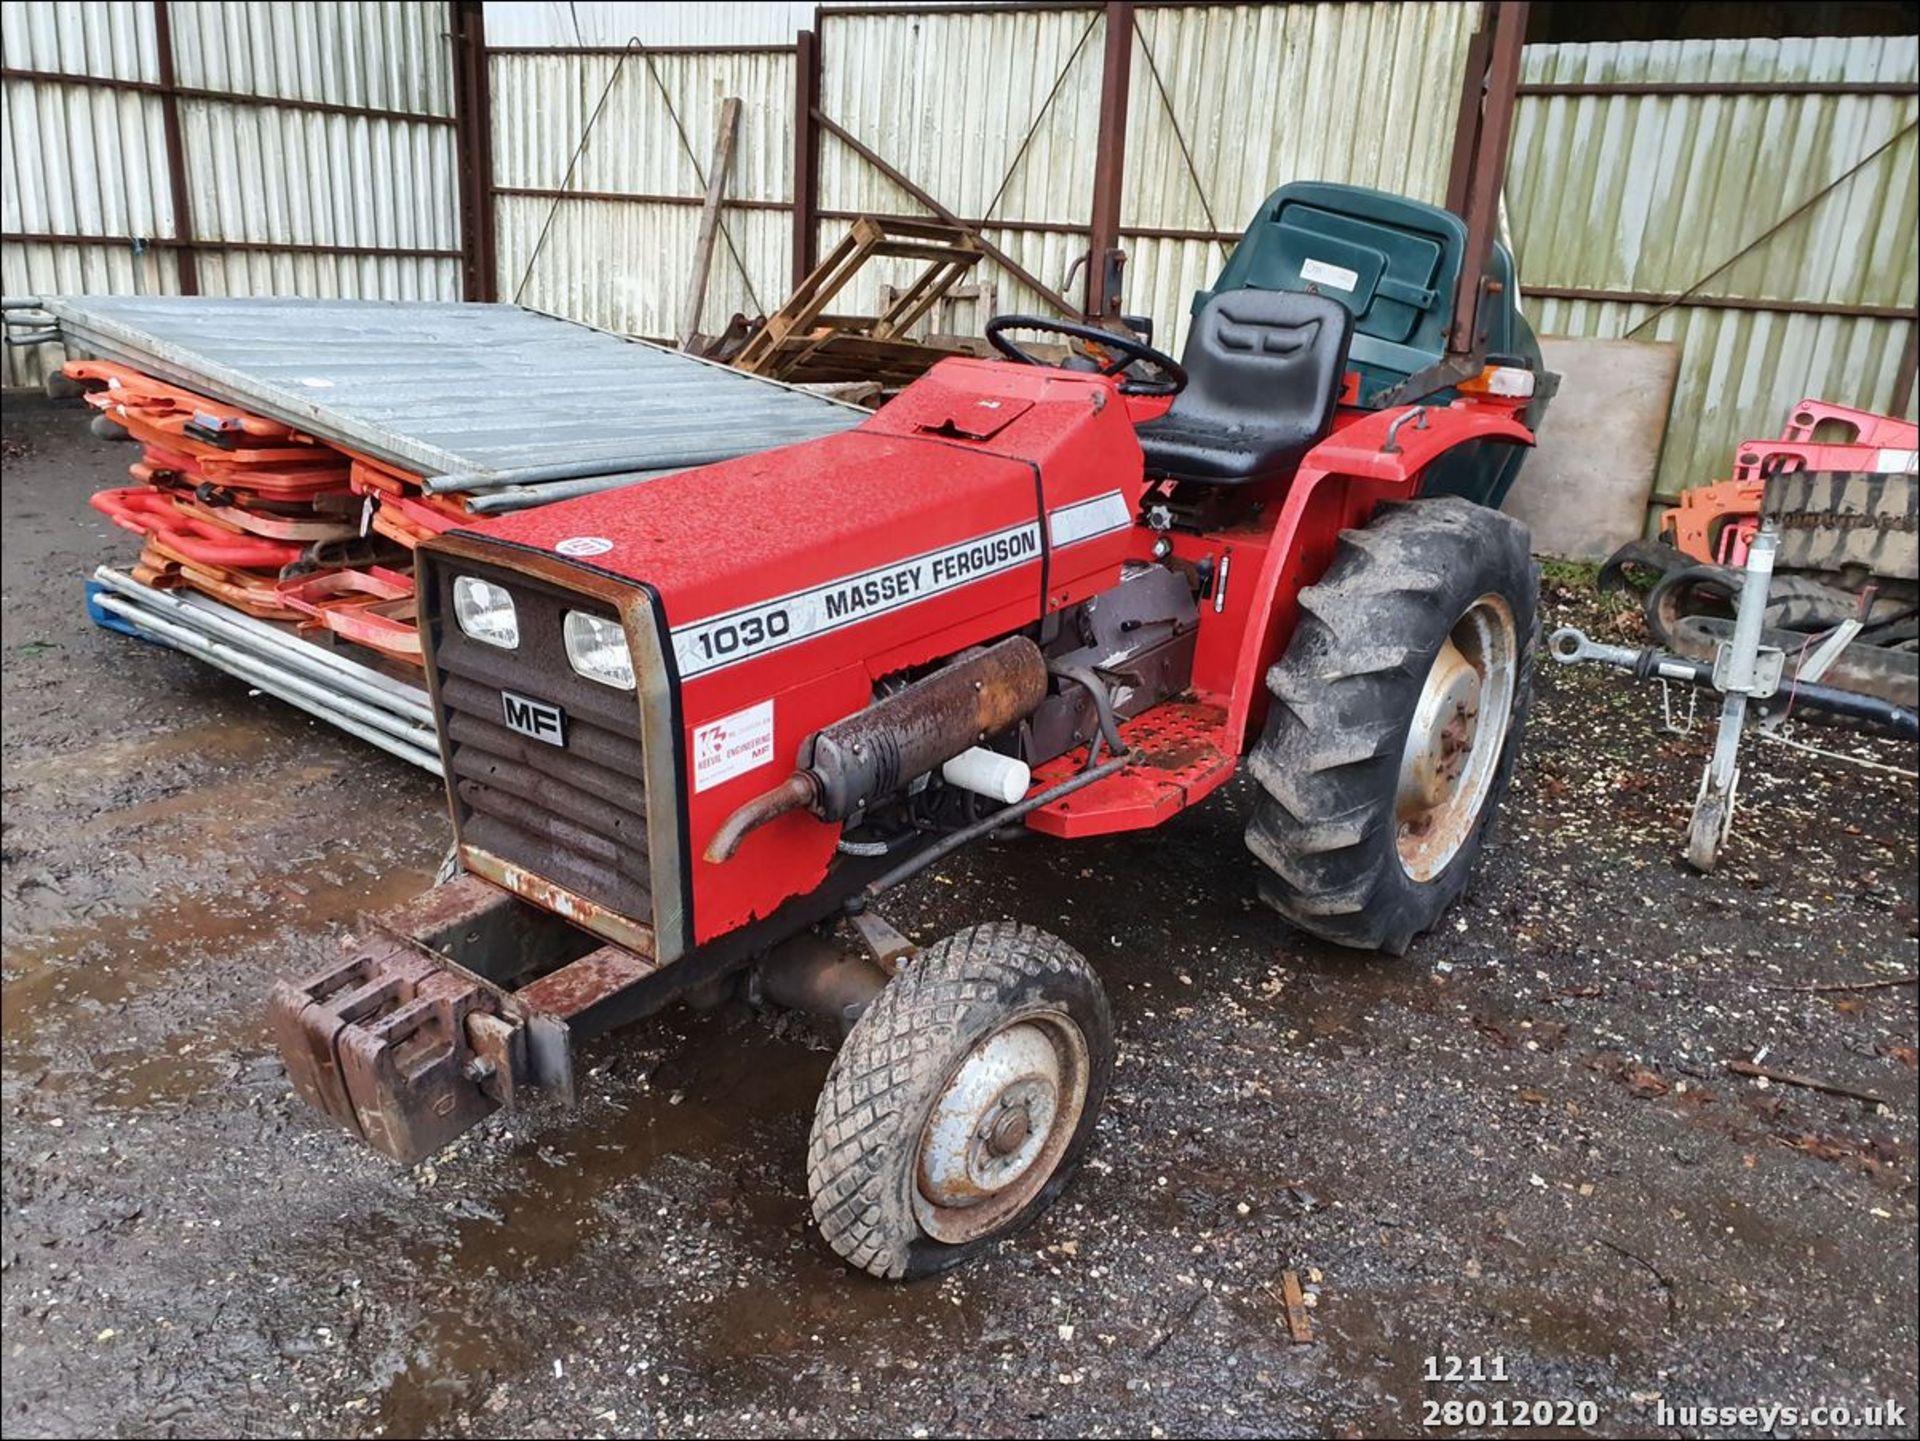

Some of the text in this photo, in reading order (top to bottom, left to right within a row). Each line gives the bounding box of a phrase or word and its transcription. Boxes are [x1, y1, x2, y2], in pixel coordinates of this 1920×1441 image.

[700, 529, 1036, 660] 1030 MASSEY FERGUSON
[505, 697, 558, 735] MF
